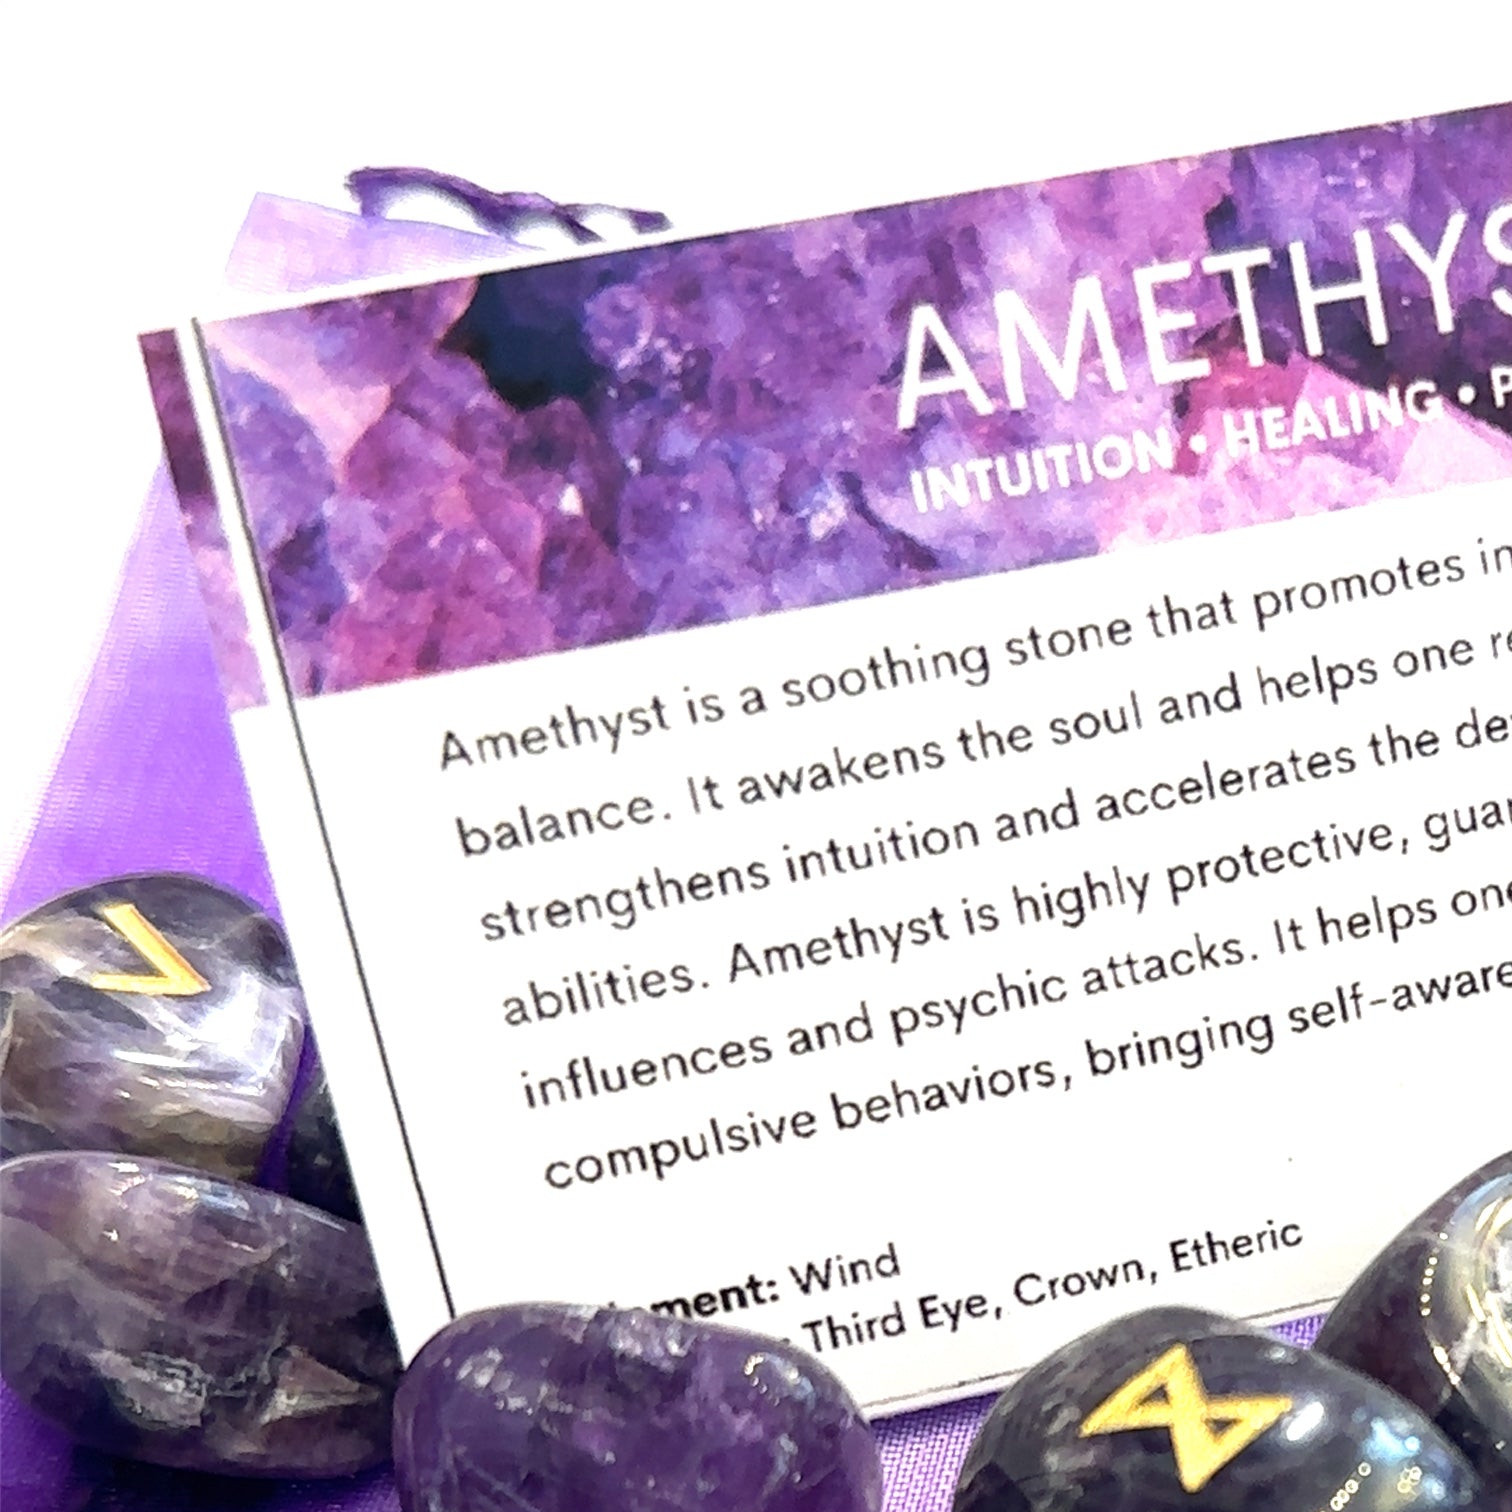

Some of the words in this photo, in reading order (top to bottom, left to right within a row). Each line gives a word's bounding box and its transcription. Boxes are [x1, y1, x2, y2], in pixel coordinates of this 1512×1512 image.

[909, 432, 1176, 514] INTUITION
[1222, 379, 1444, 459] HEALING
[440, 695, 671, 771] Amethyst
[683, 685, 726, 725] is
[739, 686, 768, 716] a
[781, 643, 991, 708] soothing
[1005, 618, 1133, 666] stone
[1145, 590, 1238, 639] that
[1252, 554, 1466, 633] promotes
[454, 796, 672, 858] balance.
[686, 775, 725, 814] It
[737, 740, 946, 805] awakens
[956, 719, 1034, 762] the
[1048, 689, 1143, 746] soul
[1158, 670, 1243, 725] and
[1256, 654, 1378, 706] helps
[1392, 639, 1475, 678] one
[480, 861, 771, 942] strengthens
[782, 820, 980, 884] intuition
[994, 786, 1081, 843] and
[1095, 746, 1357, 822] accelerates
[1367, 723, 1440, 767] the
[502, 964, 710, 1027] abilities.
[728, 906, 951, 984] Amethyst
[960, 897, 1000, 936] is
[1011, 865, 1150, 930] highly
[1166, 822, 1409, 907] protective,
[520, 1035, 773, 1110] influences
[786, 1000, 874, 1056] and
[889, 968, 1068, 1048] psychic
[1082, 932, 1259, 996] attacks.
[1273, 917, 1307, 955] It
[1315, 894, 1438, 946] helps
[544, 1110, 818, 1190] compulsive
[829, 1060, 1072, 1131] behaviors,
[1084, 1013, 1275, 1077] bringing
[787, 1241, 901, 1296] Wind
[800, 1299, 907, 1353] Third
[917, 1293, 1003, 1334] Eye,
[1012, 1259, 1158, 1307] Crown,
[1168, 1219, 1304, 1274] Etheric
